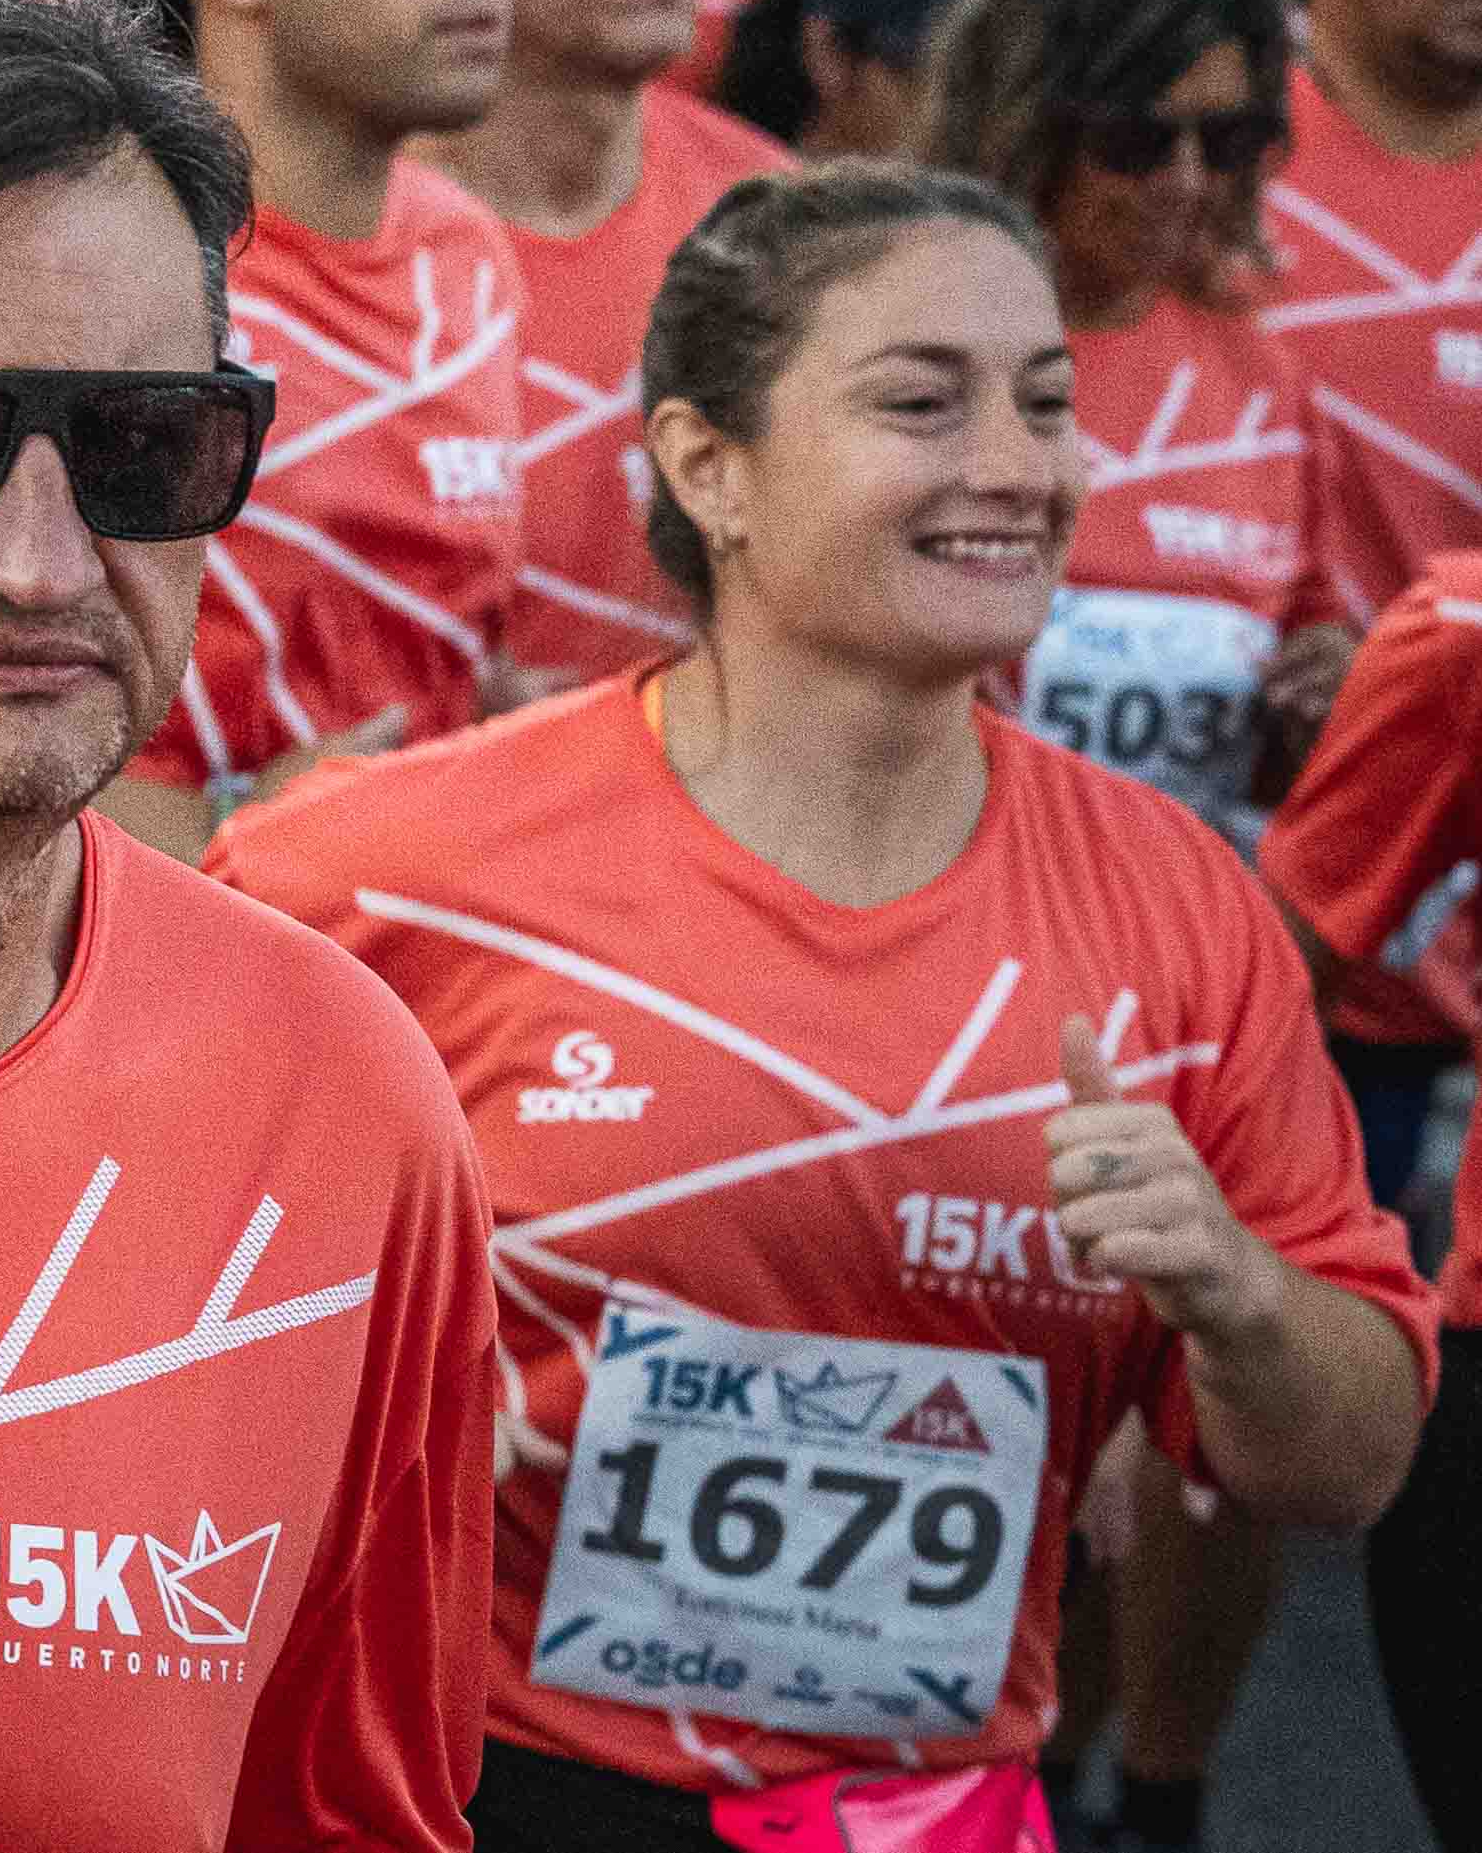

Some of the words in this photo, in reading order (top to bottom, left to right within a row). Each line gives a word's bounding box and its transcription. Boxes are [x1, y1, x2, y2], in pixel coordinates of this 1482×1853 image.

[895, 1194, 1039, 1279] 15K
[641, 1356, 758, 1418] 15K
[582, 1444, 1005, 1608] 1679
[599, 1637, 749, 1692] osde
